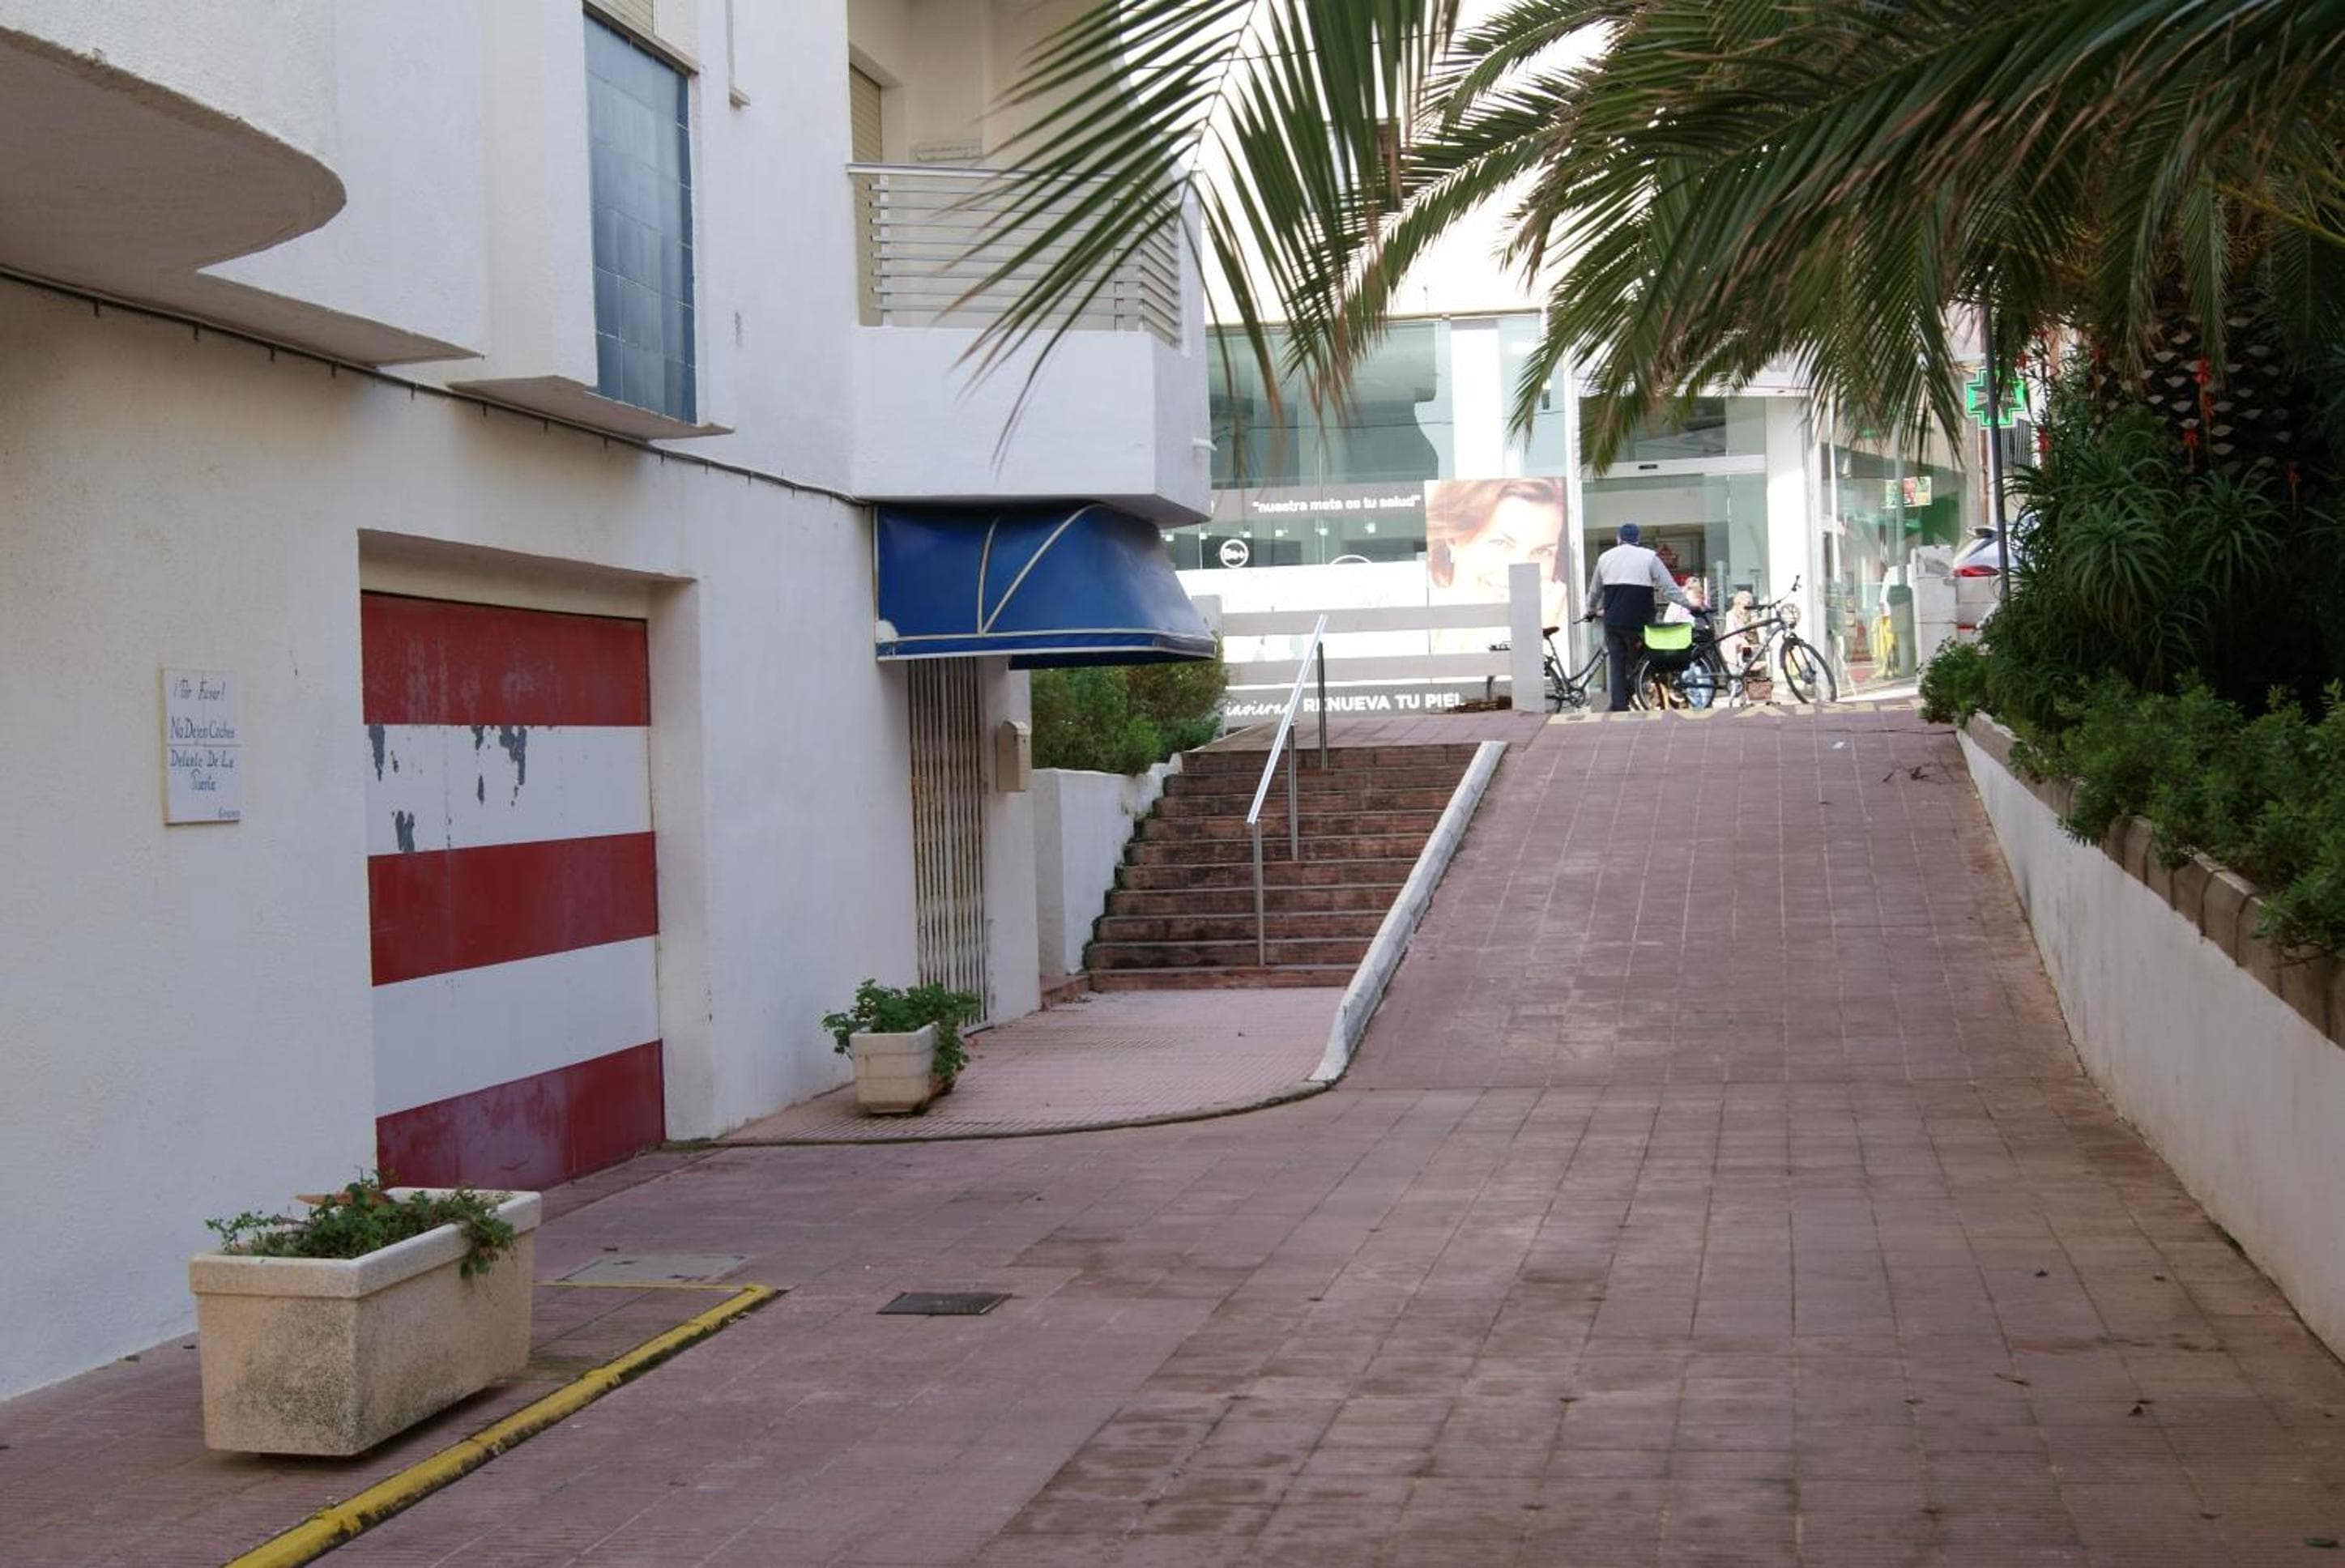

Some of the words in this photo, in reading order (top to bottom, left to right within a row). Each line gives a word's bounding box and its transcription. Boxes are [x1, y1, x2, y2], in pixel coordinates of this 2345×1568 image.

[1309, 497, 1343, 511] meta
[1345, 499, 1361, 509] es
[1362, 496, 1377, 509] tu
[1394, 693, 1420, 709] TU
[1425, 692, 1467, 708] PIEL
[170, 715, 184, 739] No
